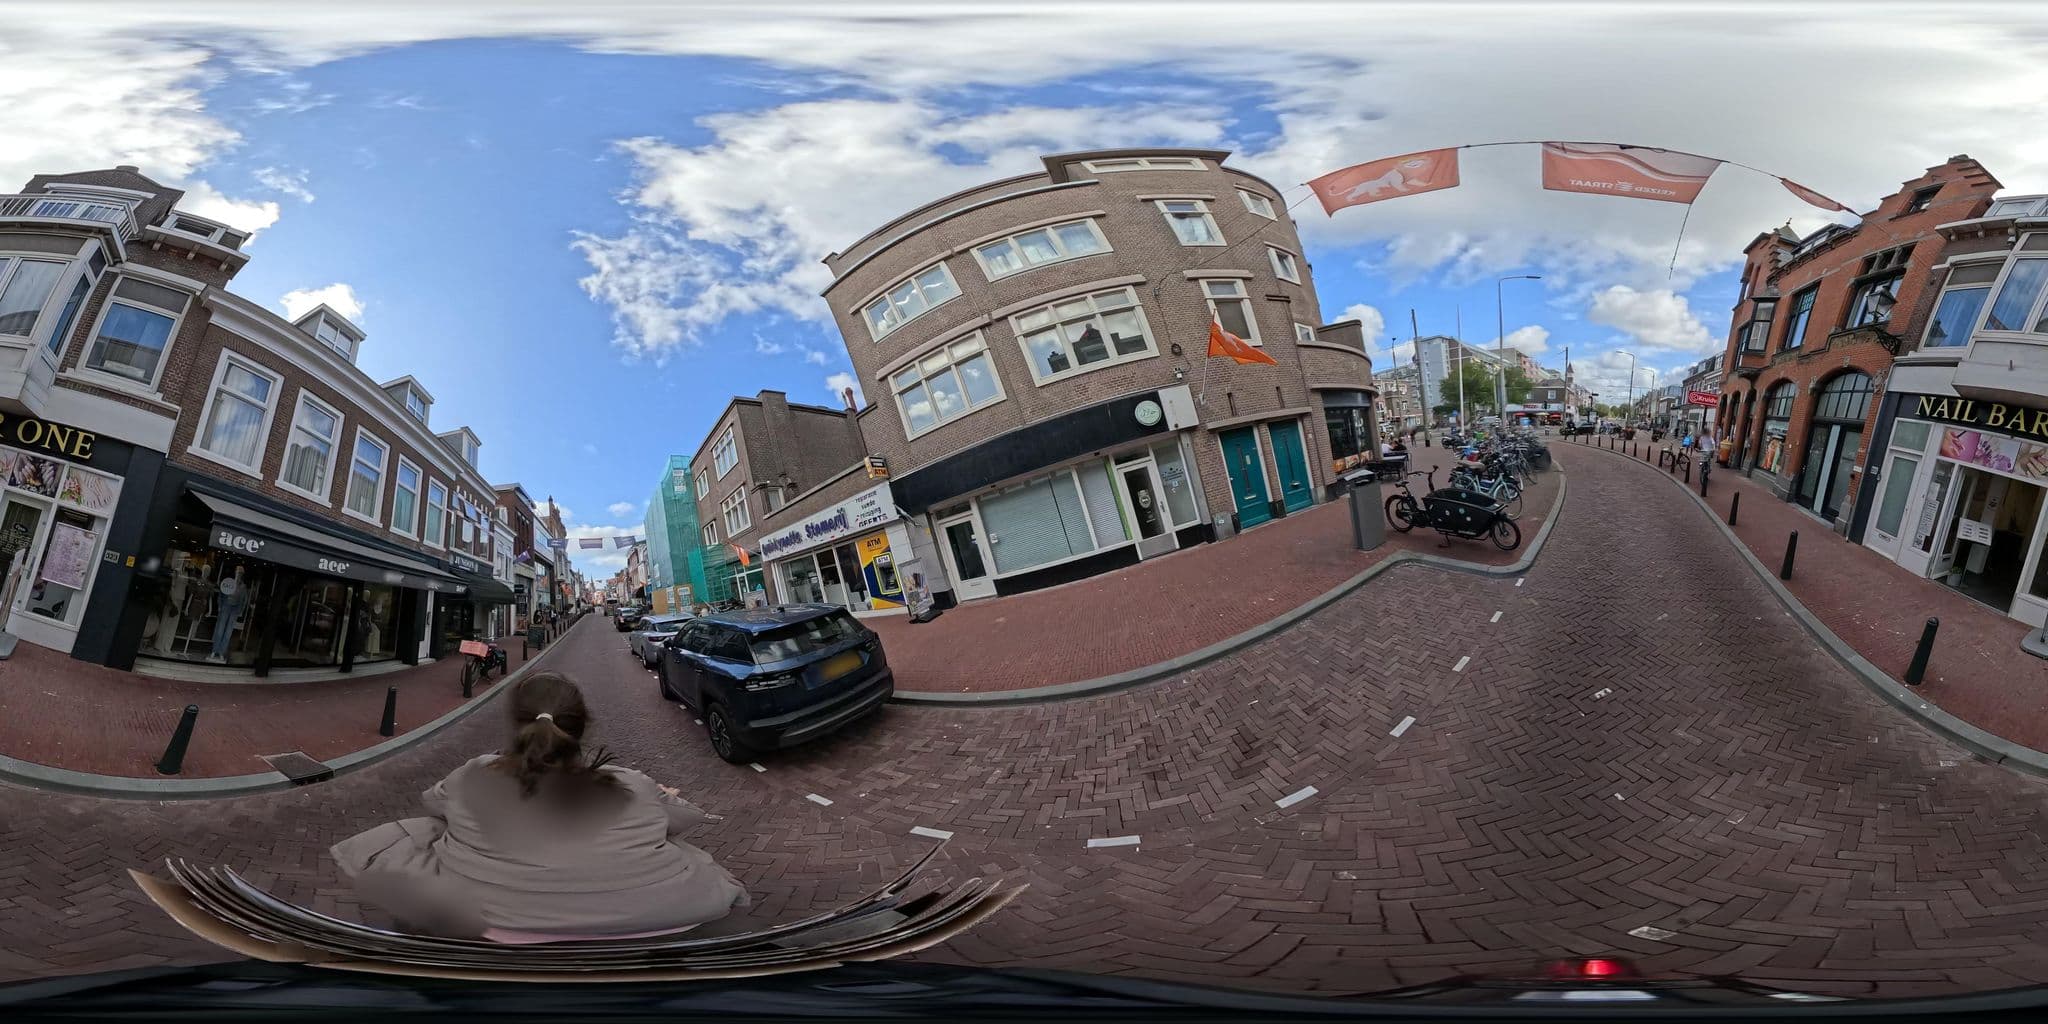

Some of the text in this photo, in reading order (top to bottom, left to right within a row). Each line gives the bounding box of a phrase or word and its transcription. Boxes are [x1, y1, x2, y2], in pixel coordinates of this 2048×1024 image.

[1915, 396, 1978, 423] NAIL
[17, 419, 96, 460] ONE
[805, 507, 850, 539] Stomerij
[866, 537, 881, 548] ATM
[877, 555, 889, 563] ATM
